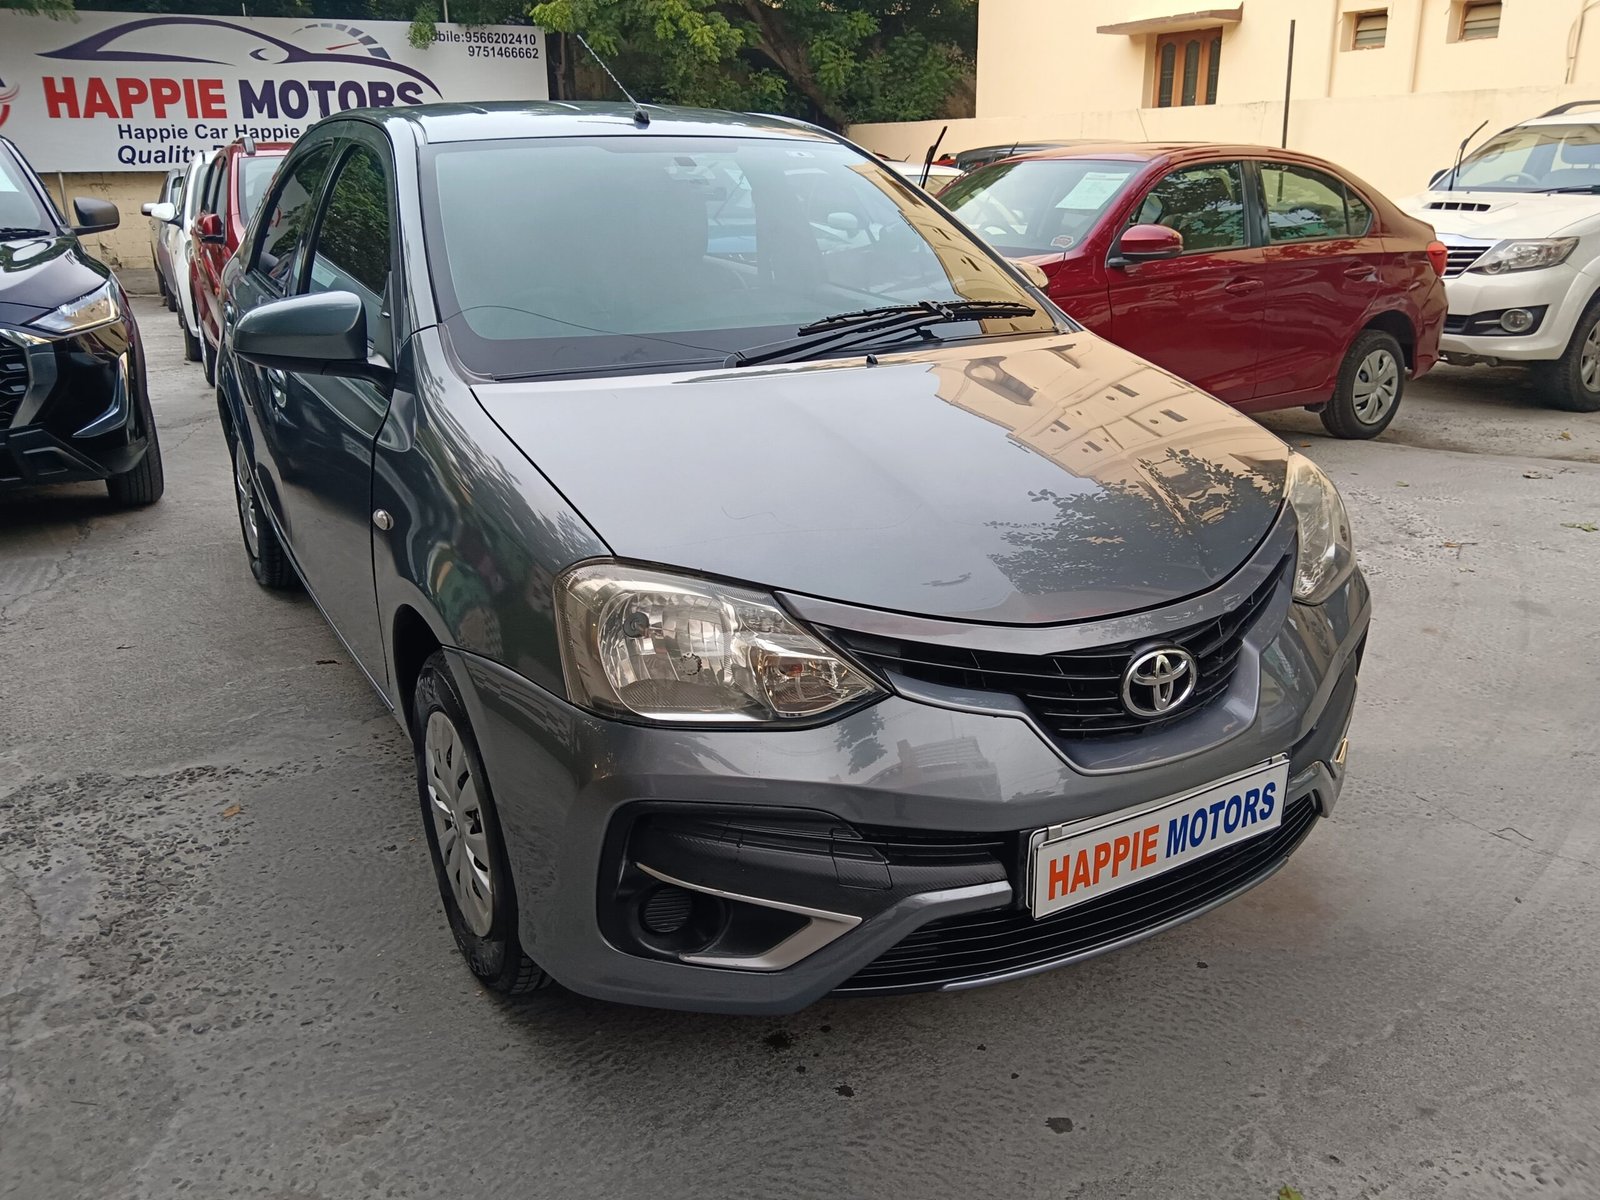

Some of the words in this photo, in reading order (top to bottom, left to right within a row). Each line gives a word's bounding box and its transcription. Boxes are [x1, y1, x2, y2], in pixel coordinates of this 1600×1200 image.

[430, 30, 537, 46] obile:9566202410
[468, 45, 539, 59] 9751466662
[42, 76, 227, 119] HAPPIE
[238, 79, 424, 119] MOTORS
[117, 124, 188, 143] Happie
[194, 124, 228, 140] Car
[234, 124, 300, 142] Happie
[117, 145, 195, 165] Qualit
[1048, 824, 1160, 901] HAPPIE
[1165, 781, 1276, 858] MOTORS
